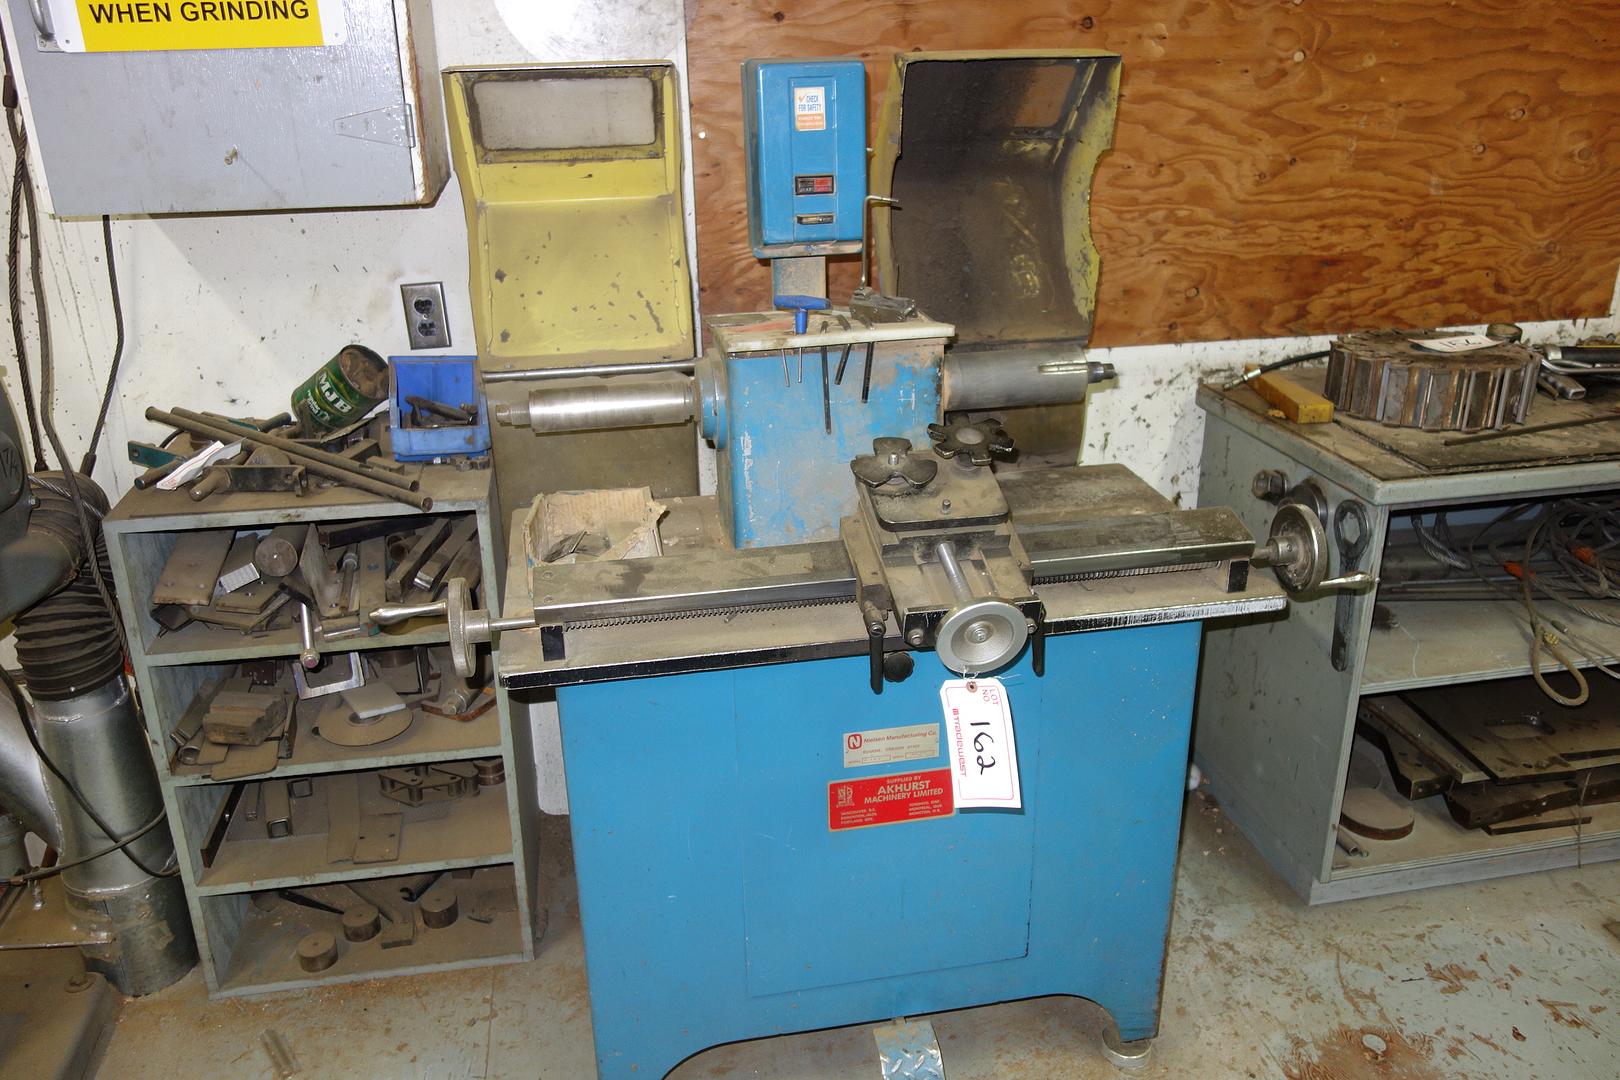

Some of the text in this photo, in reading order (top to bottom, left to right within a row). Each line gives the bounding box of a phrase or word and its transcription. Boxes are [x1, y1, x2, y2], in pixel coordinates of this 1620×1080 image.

[89, 0, 309, 23] WHEN GRINDING
[320, 371, 352, 413] MJB
[989, 688, 999, 705] LOT
[863, 735, 885, 743] Nielsen
[886, 730, 927, 740] Manufacturing
[969, 721, 996, 775] 162
[877, 780, 931, 794] AKHURST
[886, 775, 912, 784] SUPPLIED
[864, 791, 911, 804] MACHINERY
[913, 787, 943, 798] LIMITED
